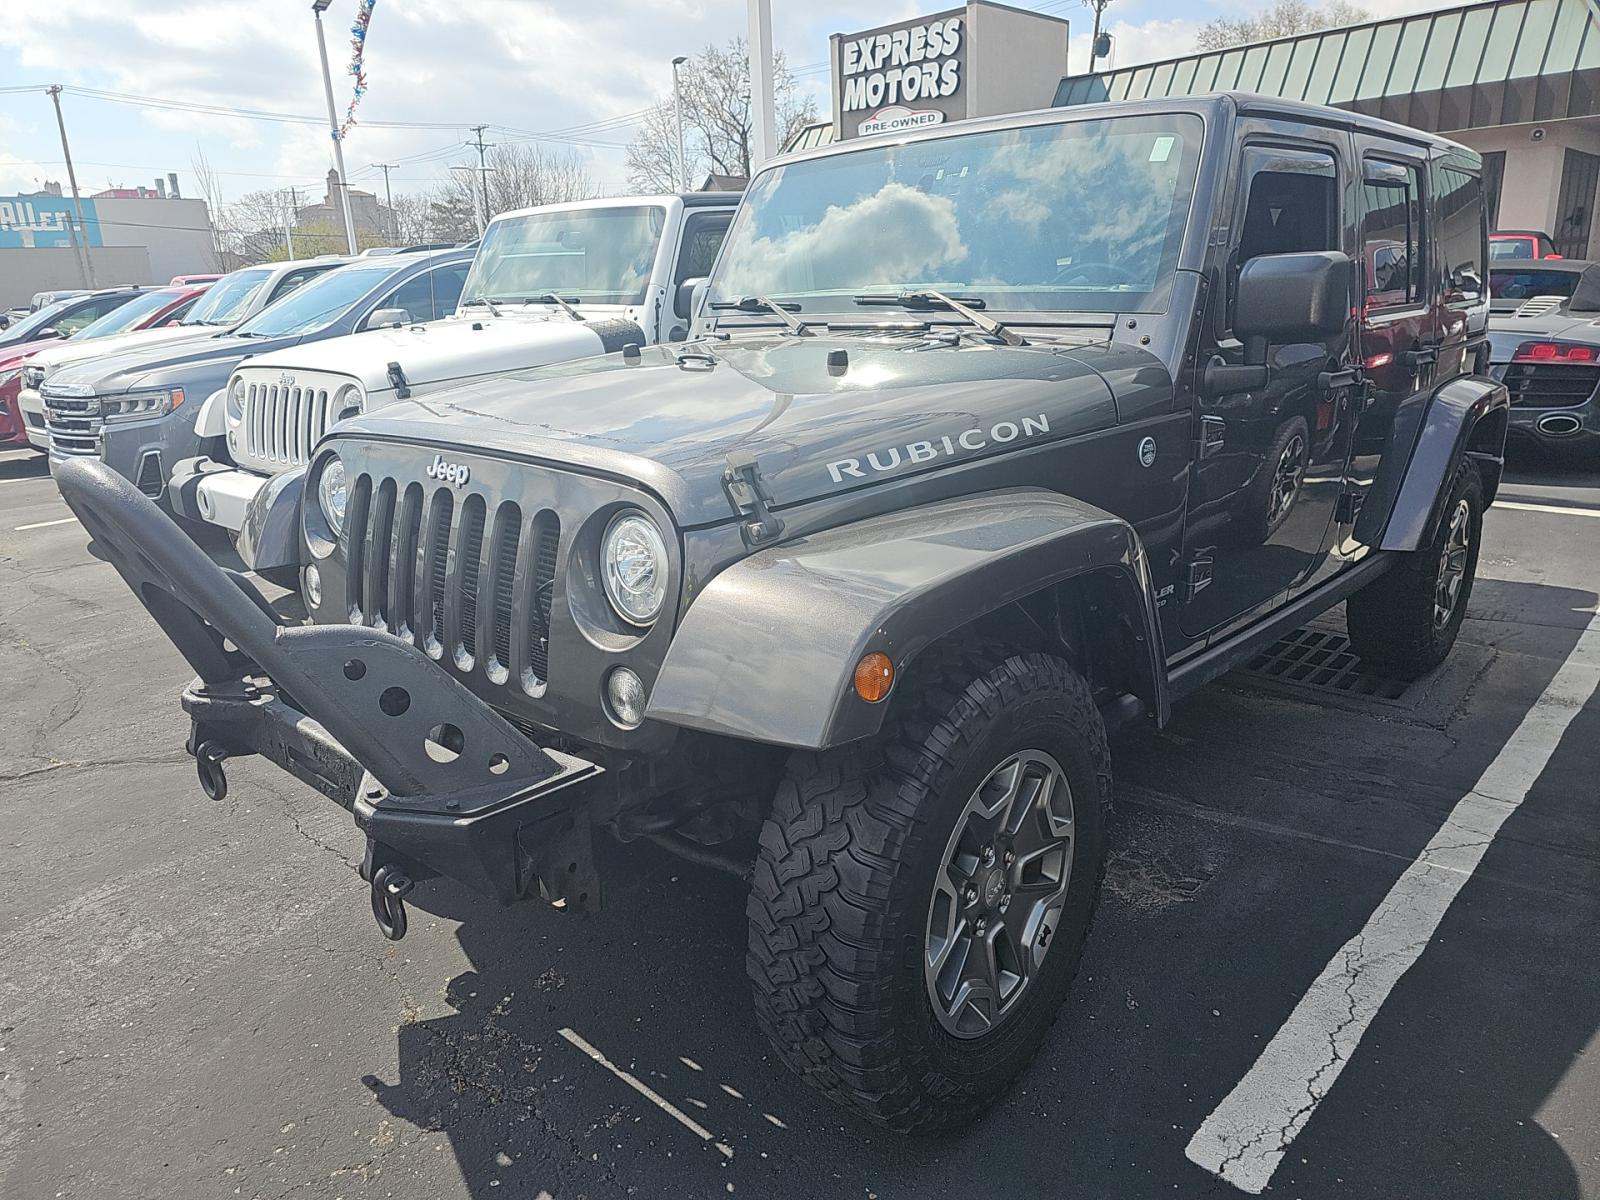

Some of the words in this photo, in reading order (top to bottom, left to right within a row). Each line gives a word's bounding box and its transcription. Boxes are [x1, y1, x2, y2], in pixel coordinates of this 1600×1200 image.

[843, 18, 962, 75] EXPRESS
[842, 59, 960, 111] MOTORS
[865, 114, 936, 133] PRE-OWNED
[426, 455, 470, 489] Jeep
[826, 413, 1050, 483] RUBICON
